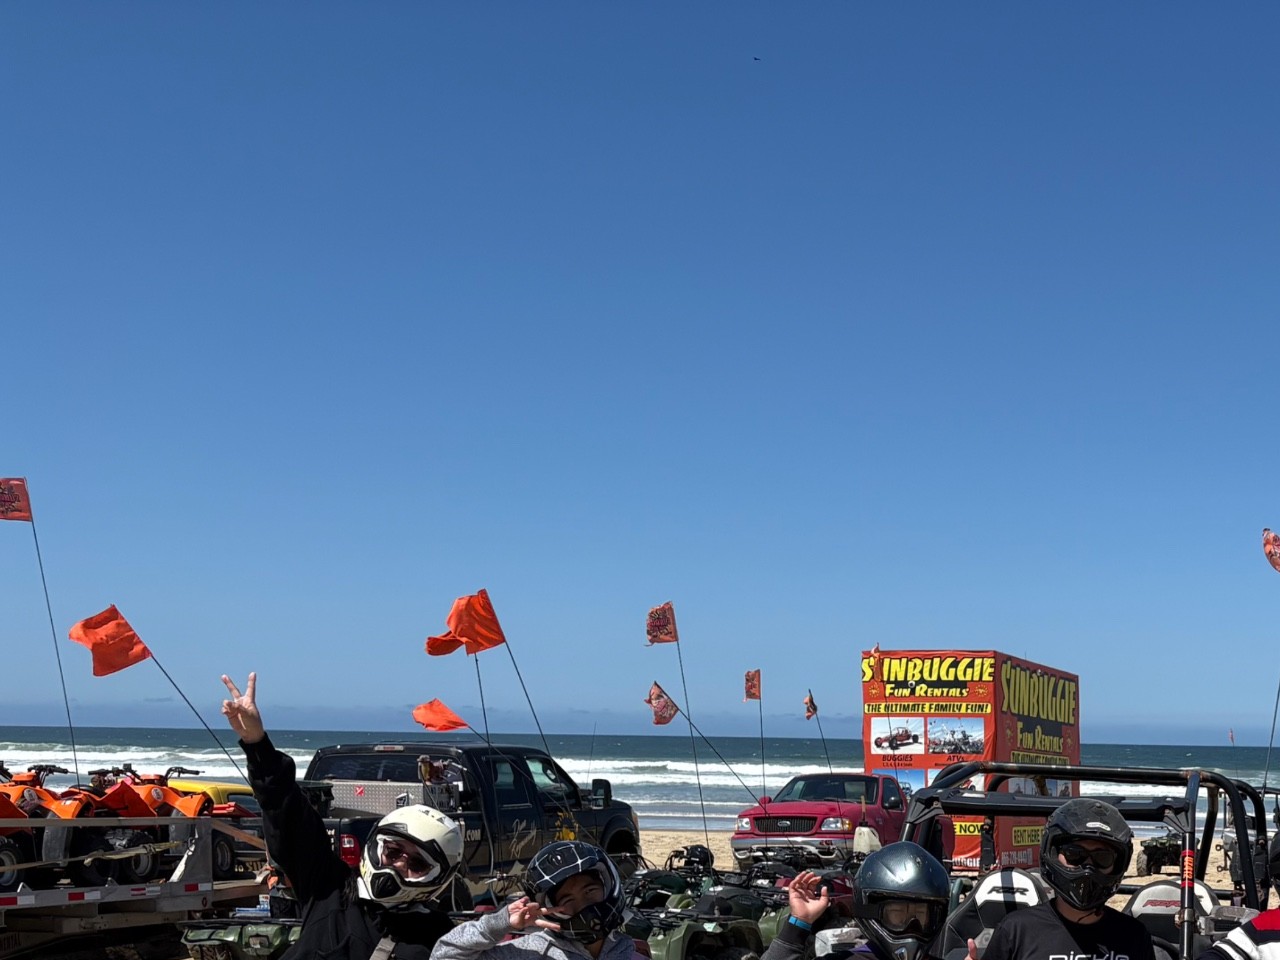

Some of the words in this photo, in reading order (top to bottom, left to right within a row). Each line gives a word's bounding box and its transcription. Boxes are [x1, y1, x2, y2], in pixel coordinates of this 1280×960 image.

[1001, 660, 1076, 725] SUNBUGGIE
[866, 703, 882, 713] THE
[884, 703, 926, 713] ULTIMATE
[928, 703, 963, 713] FAMILY
[965, 703, 989, 713] FUN!
[882, 754, 913, 762] BUGGIES
